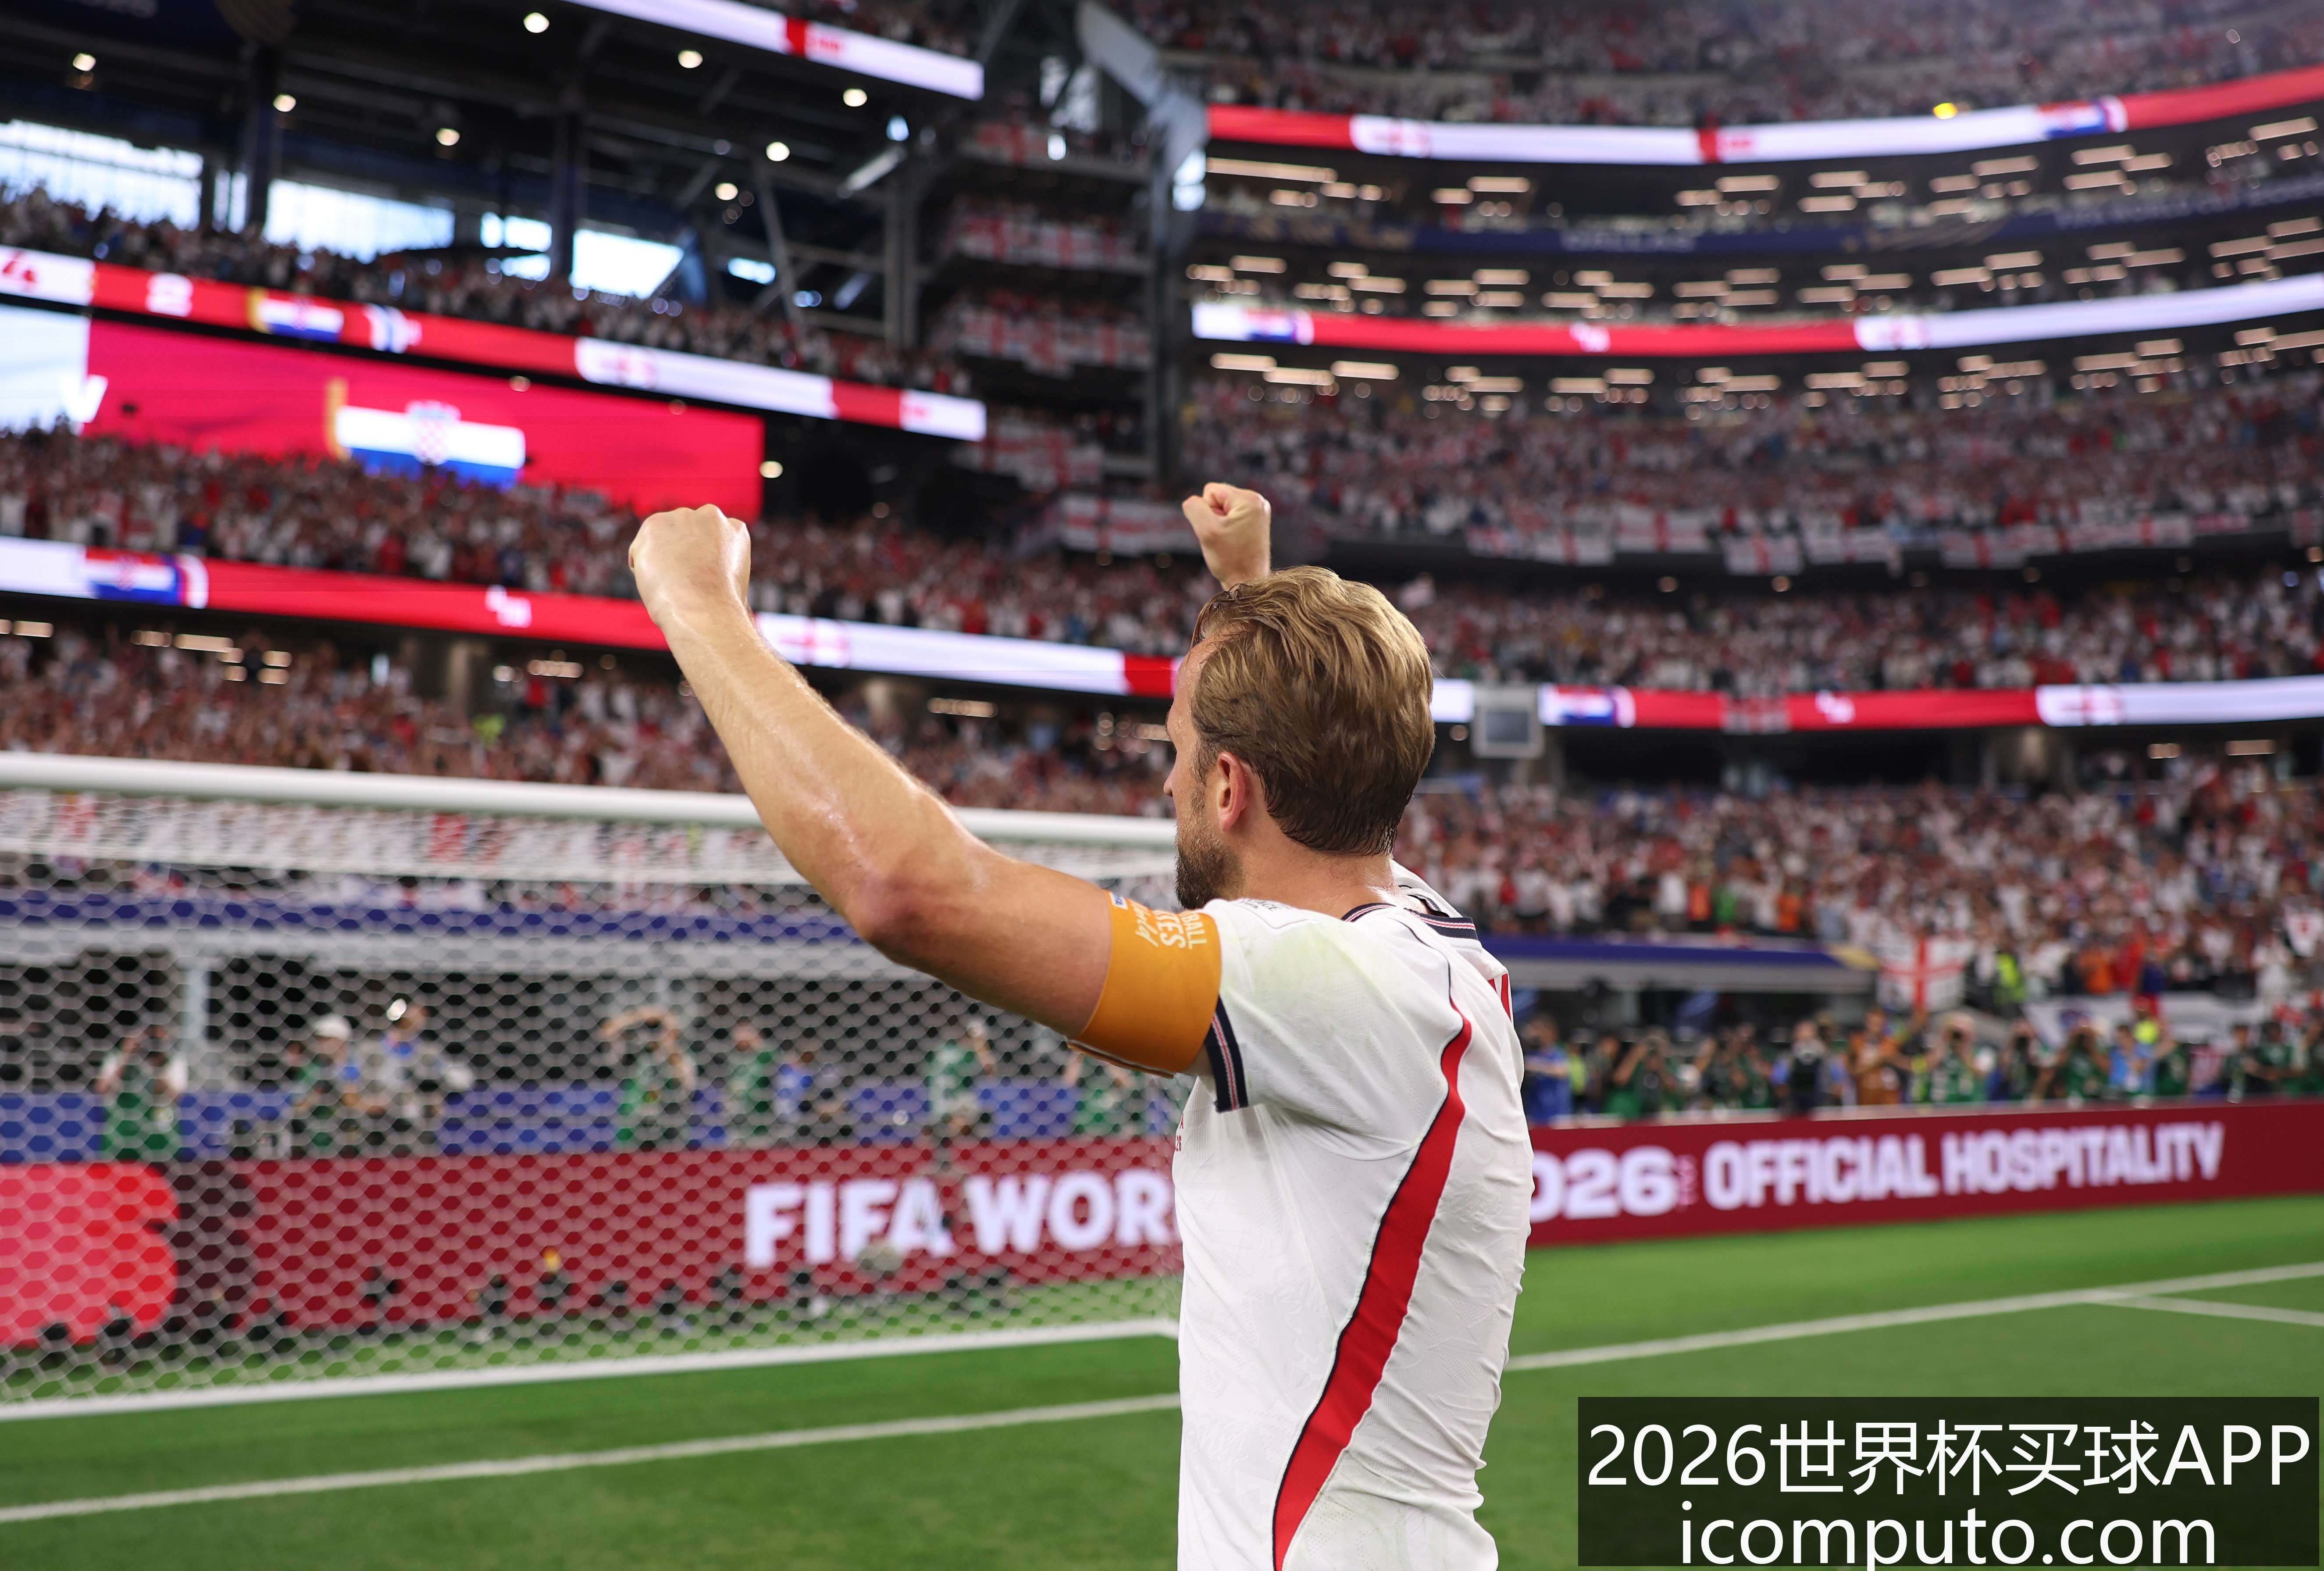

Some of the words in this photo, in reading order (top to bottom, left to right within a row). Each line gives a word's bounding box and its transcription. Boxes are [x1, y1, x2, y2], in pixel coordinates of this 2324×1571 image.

[744, 1180, 954, 1268] FIFA
[966, 1168, 1180, 1256] WOR
[1529, 1146, 1680, 1224] 026
[1703, 1133, 1939, 1210] OFFICIAL
[1941, 1120, 2224, 1195] HOSPITALITY
